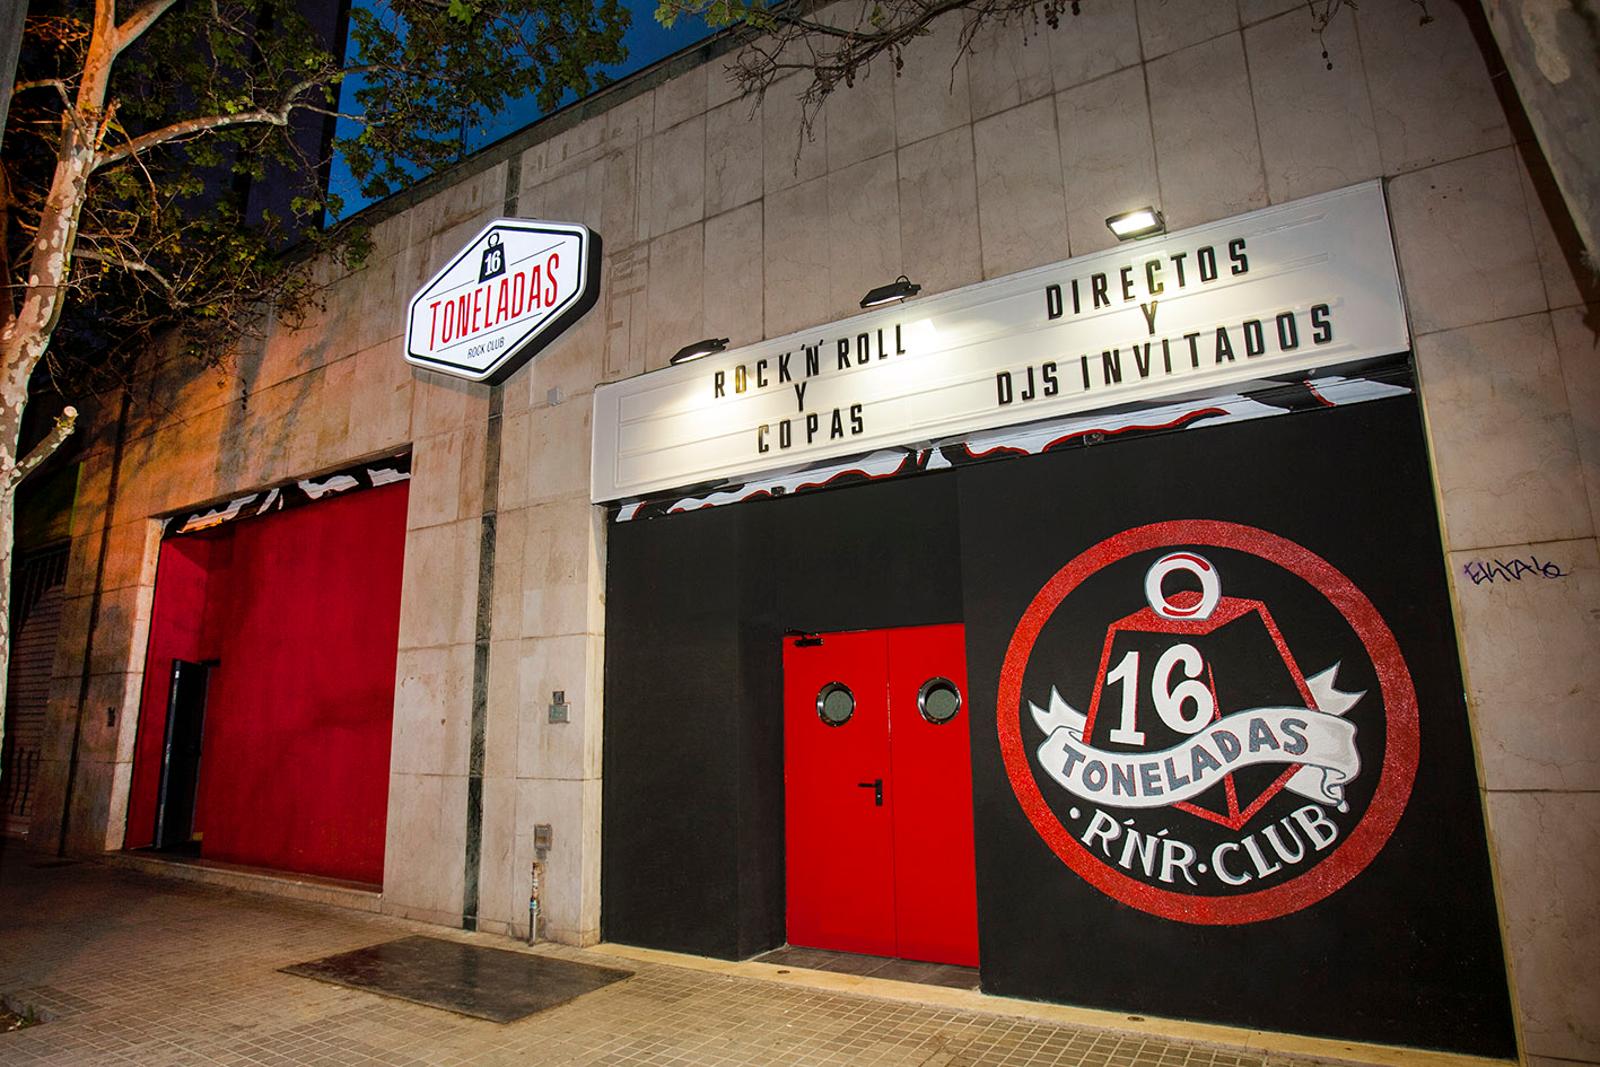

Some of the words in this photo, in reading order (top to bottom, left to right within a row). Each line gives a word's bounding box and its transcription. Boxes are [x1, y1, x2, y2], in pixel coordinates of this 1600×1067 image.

[484, 251, 501, 276] 16
[1045, 238, 1249, 321] DIRECTOS
[429, 253, 559, 351] TONELADAS
[1140, 300, 1159, 335] Y
[467, 344, 486, 358] ROCK
[486, 337, 504, 353] CLUB
[837, 324, 906, 370] ROLL
[996, 361, 1059, 407] DJS
[1081, 303, 1333, 391] INVITADOS
[758, 404, 864, 453] COPAS
[794, 382, 807, 412] Y
[1107, 644, 1214, 746] 16
[1062, 717, 1309, 798] TONELADAS
[1211, 804, 1339, 885] CLUB
